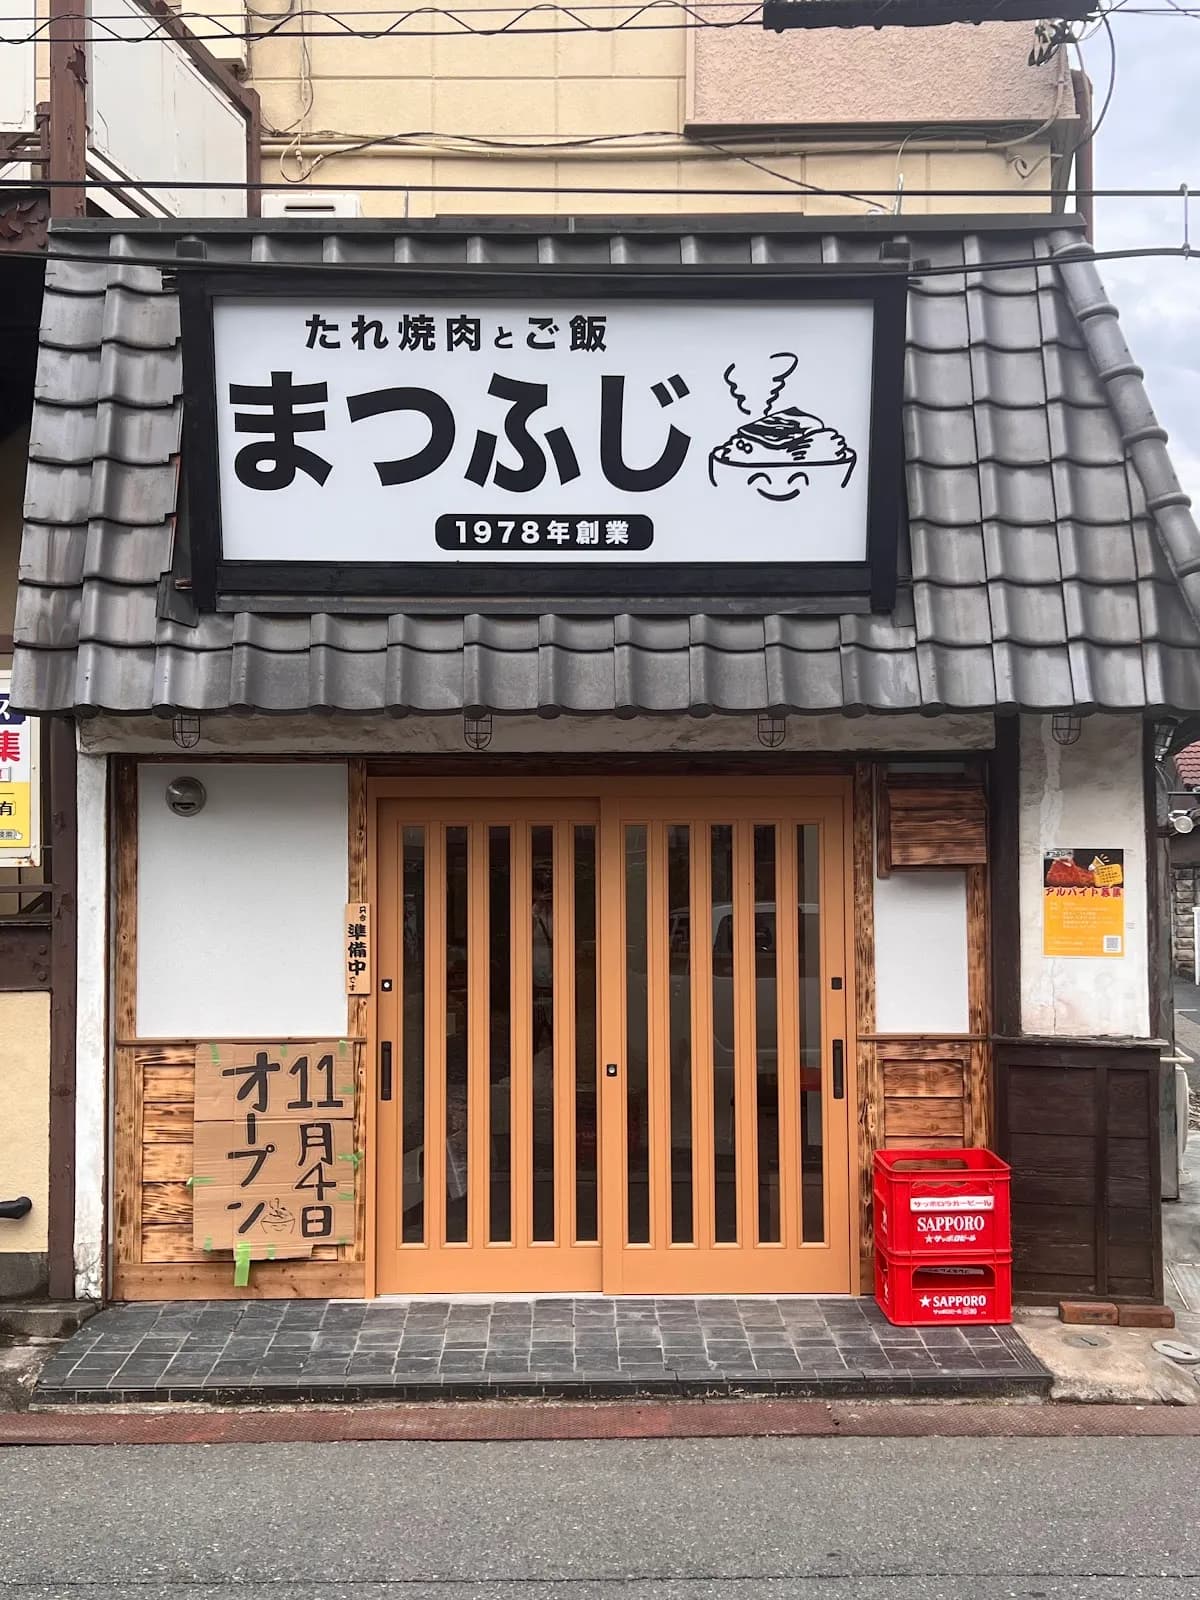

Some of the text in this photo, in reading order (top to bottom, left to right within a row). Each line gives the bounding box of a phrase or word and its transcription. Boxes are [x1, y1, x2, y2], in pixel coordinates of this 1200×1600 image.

[304, 313, 608, 353] たれ焼肉とご飯
[229, 371, 692, 493] まつふじ
[455, 519, 629, 545] 1978年創業
[222, 1052, 281, 1234] オープン
[917, 1215, 985, 1232] SAPPORO
[932, 1294, 987, 1307] SAPPORO
